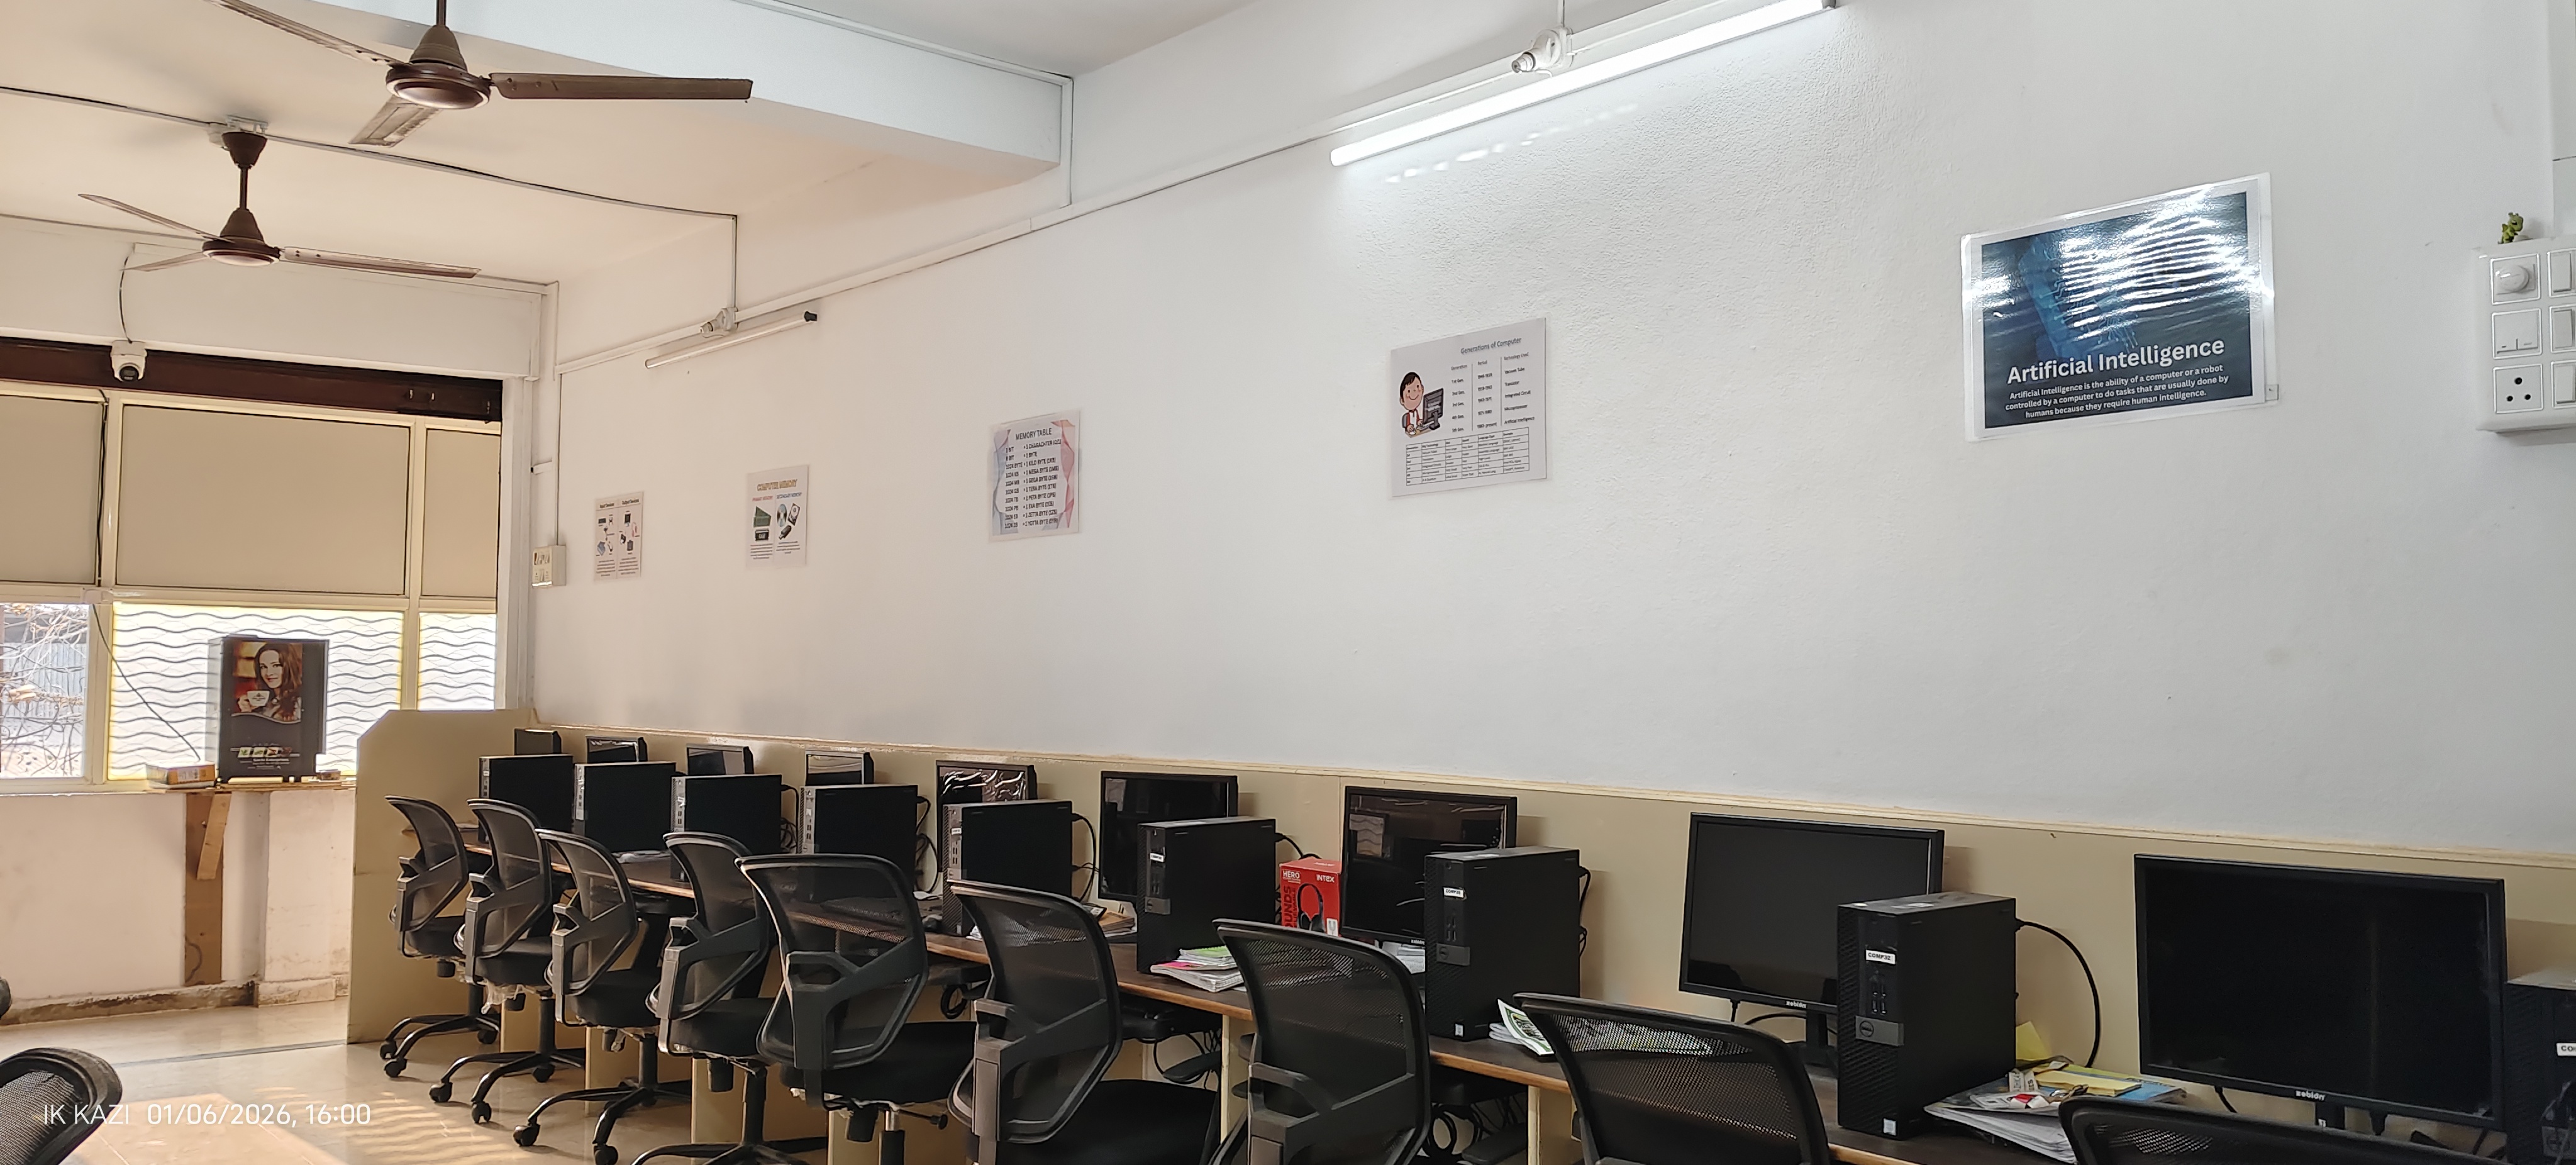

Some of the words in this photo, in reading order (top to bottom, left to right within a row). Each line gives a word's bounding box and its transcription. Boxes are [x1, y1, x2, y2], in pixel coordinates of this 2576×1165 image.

[1460, 344, 1490, 354] Generations
[1497, 338, 1522, 347] Computer
[2007, 354, 2094, 384] Artificial
[2099, 339, 2224, 371] Intelligence
[2006, 399, 2042, 411] controlled
[2043, 398, 2052, 407] by
[2059, 393, 2095, 404] computer
[2104, 389, 2114, 398] do
[2116, 387, 2135, 396] tasks
[2136, 385, 2153, 394] that
[2168, 379, 2196, 389] usually
[2197, 377, 2218, 386] done
[2219, 375, 2229, 384] by
[2010, 389, 2040, 399] Artificial
[2041, 384, 2083, 396] Intelligence
[2092, 381, 2104, 389] the
[2105, 377, 2128, 386] ability
[2131, 376, 2139, 384] of
[2146, 371, 2184, 381] computer
[2201, 365, 2224, 374] robot
[2026, 410, 2054, 418] humans
[2055, 405, 2085, 415] because
[2085, 403, 2102, 411] they
[2103, 397, 2130, 409] require
[2131, 396, 2158, 405] human
[1016, 430, 1036, 440] MEMORY
[1037, 428, 1052, 437] TABLE
[1283, 870, 1300, 879] HERO
